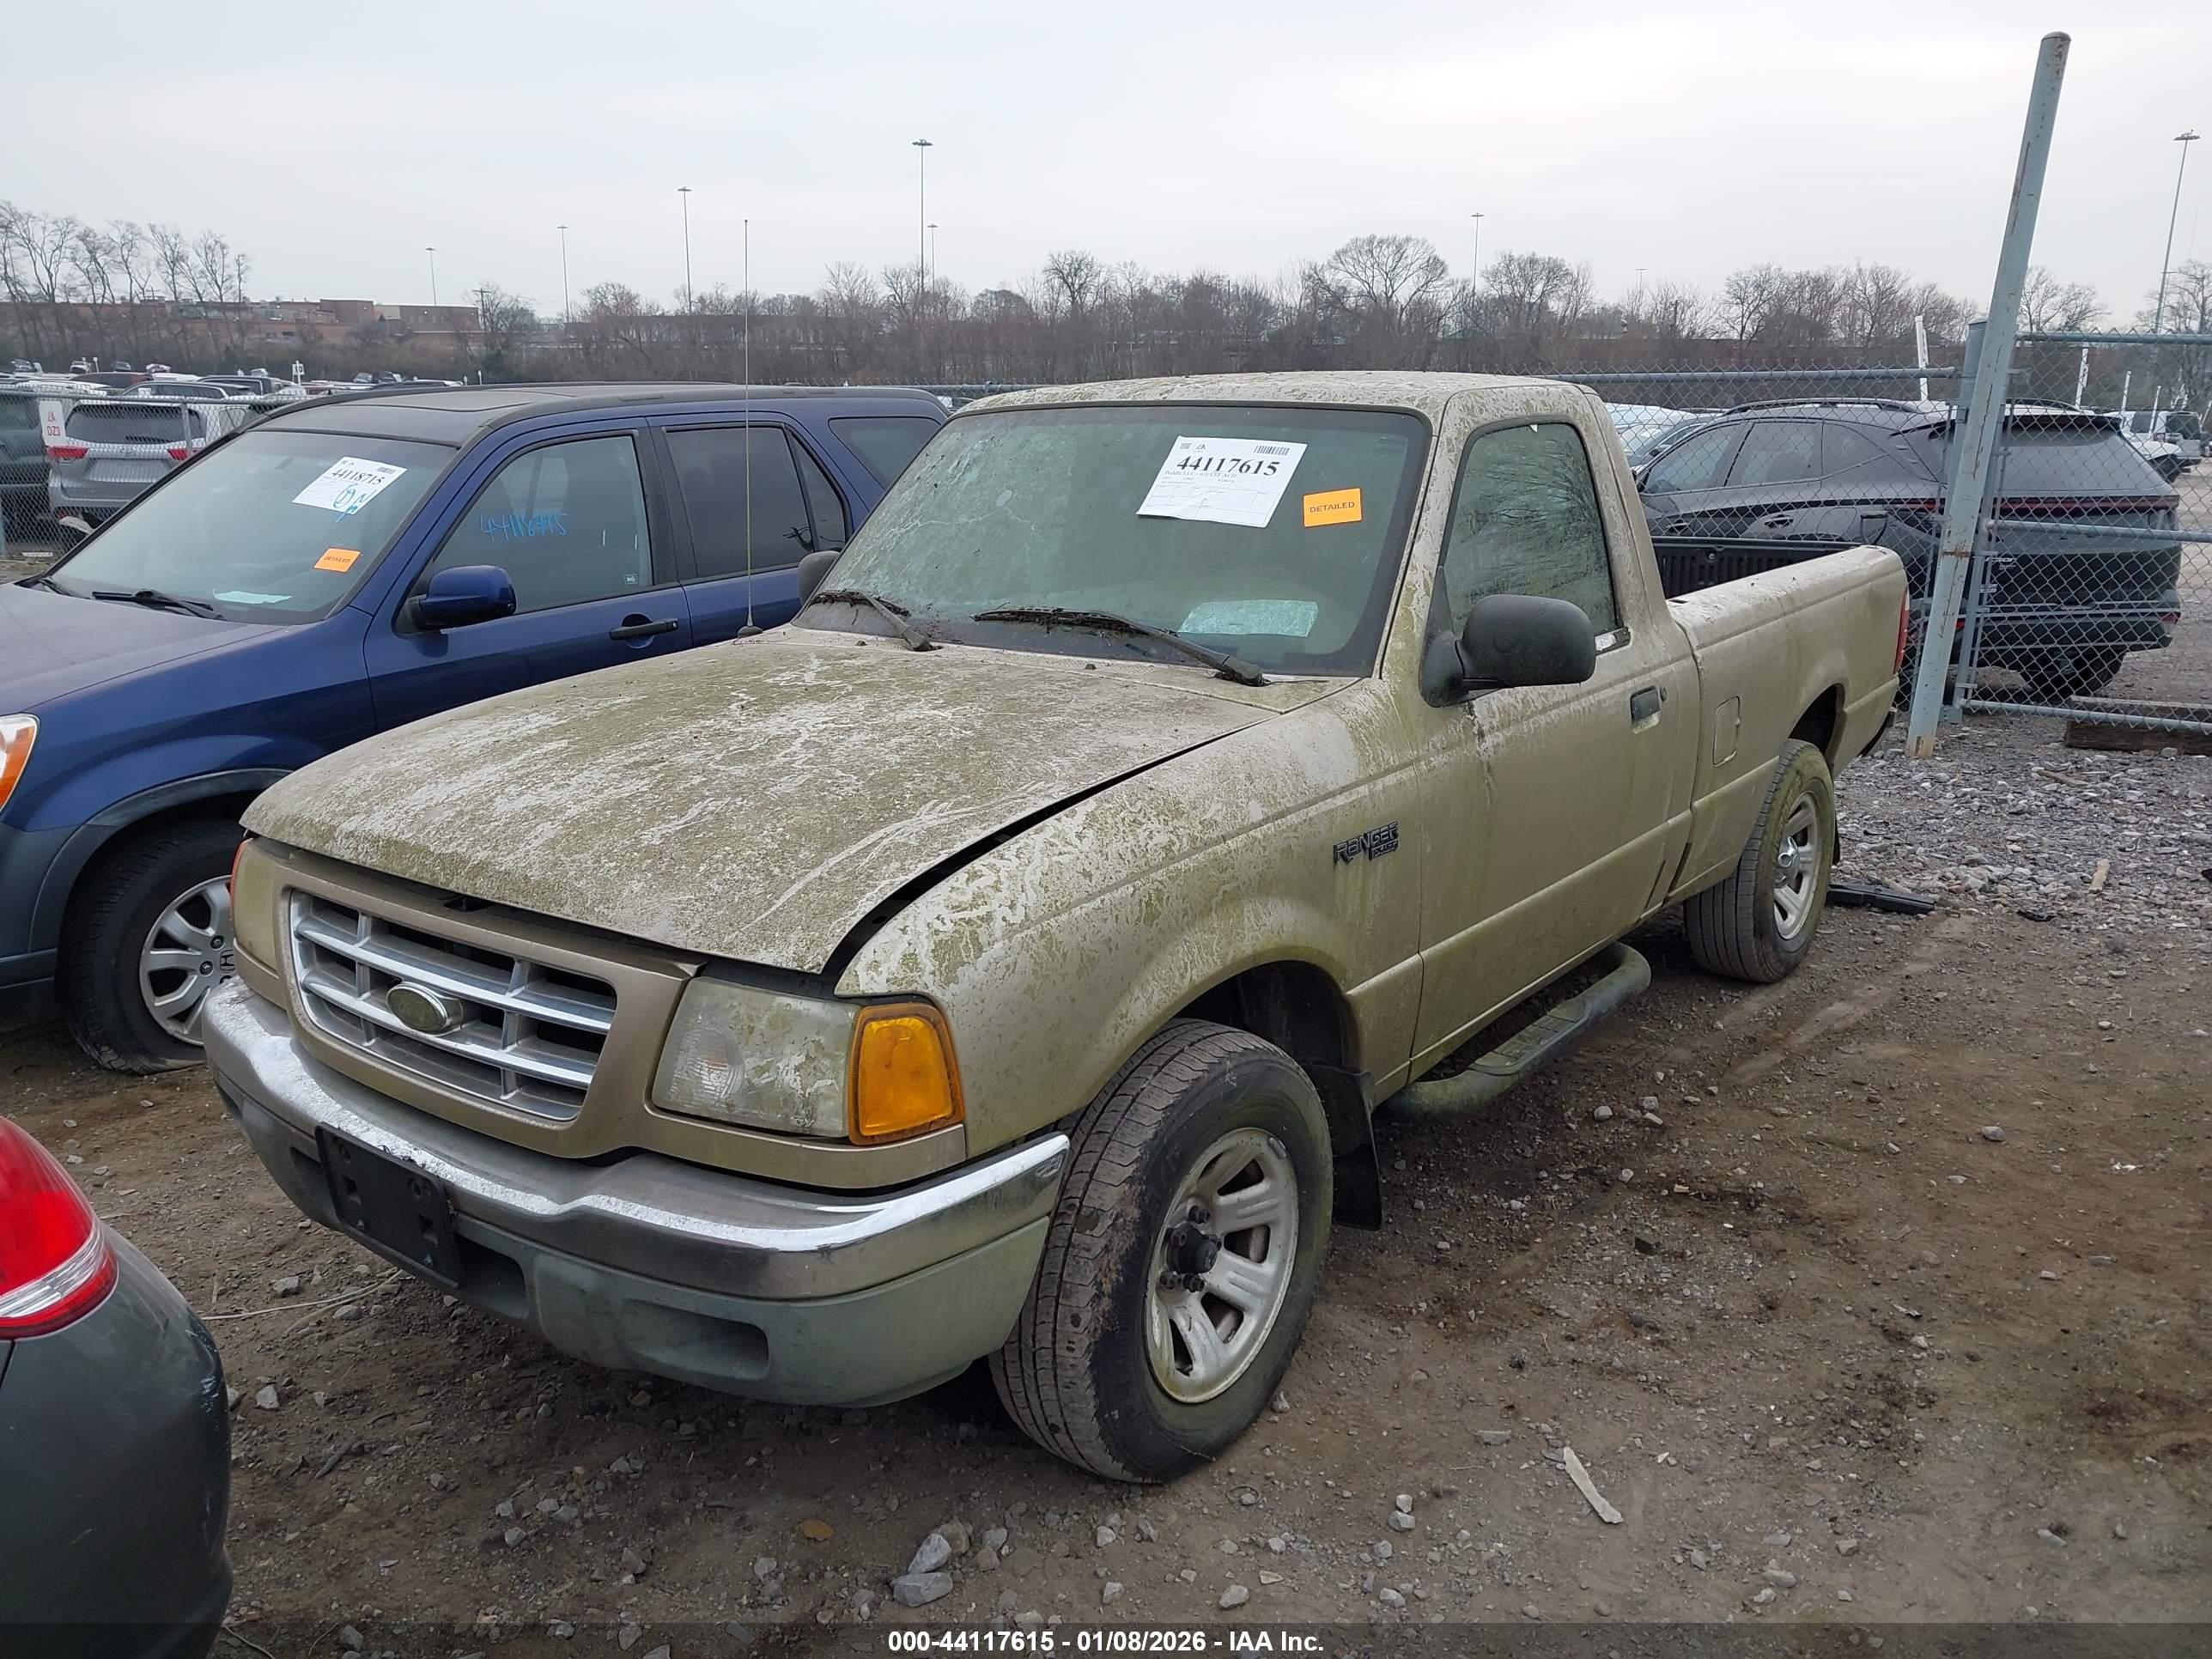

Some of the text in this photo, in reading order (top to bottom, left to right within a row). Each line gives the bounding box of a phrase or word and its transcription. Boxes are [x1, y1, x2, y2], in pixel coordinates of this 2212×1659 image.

[1176, 455, 1281, 477] 44117615
[331, 468, 386, 485] 44118715
[1310, 501, 1355, 514] DETAILED
[1333, 821, 1399, 862] RANGER
